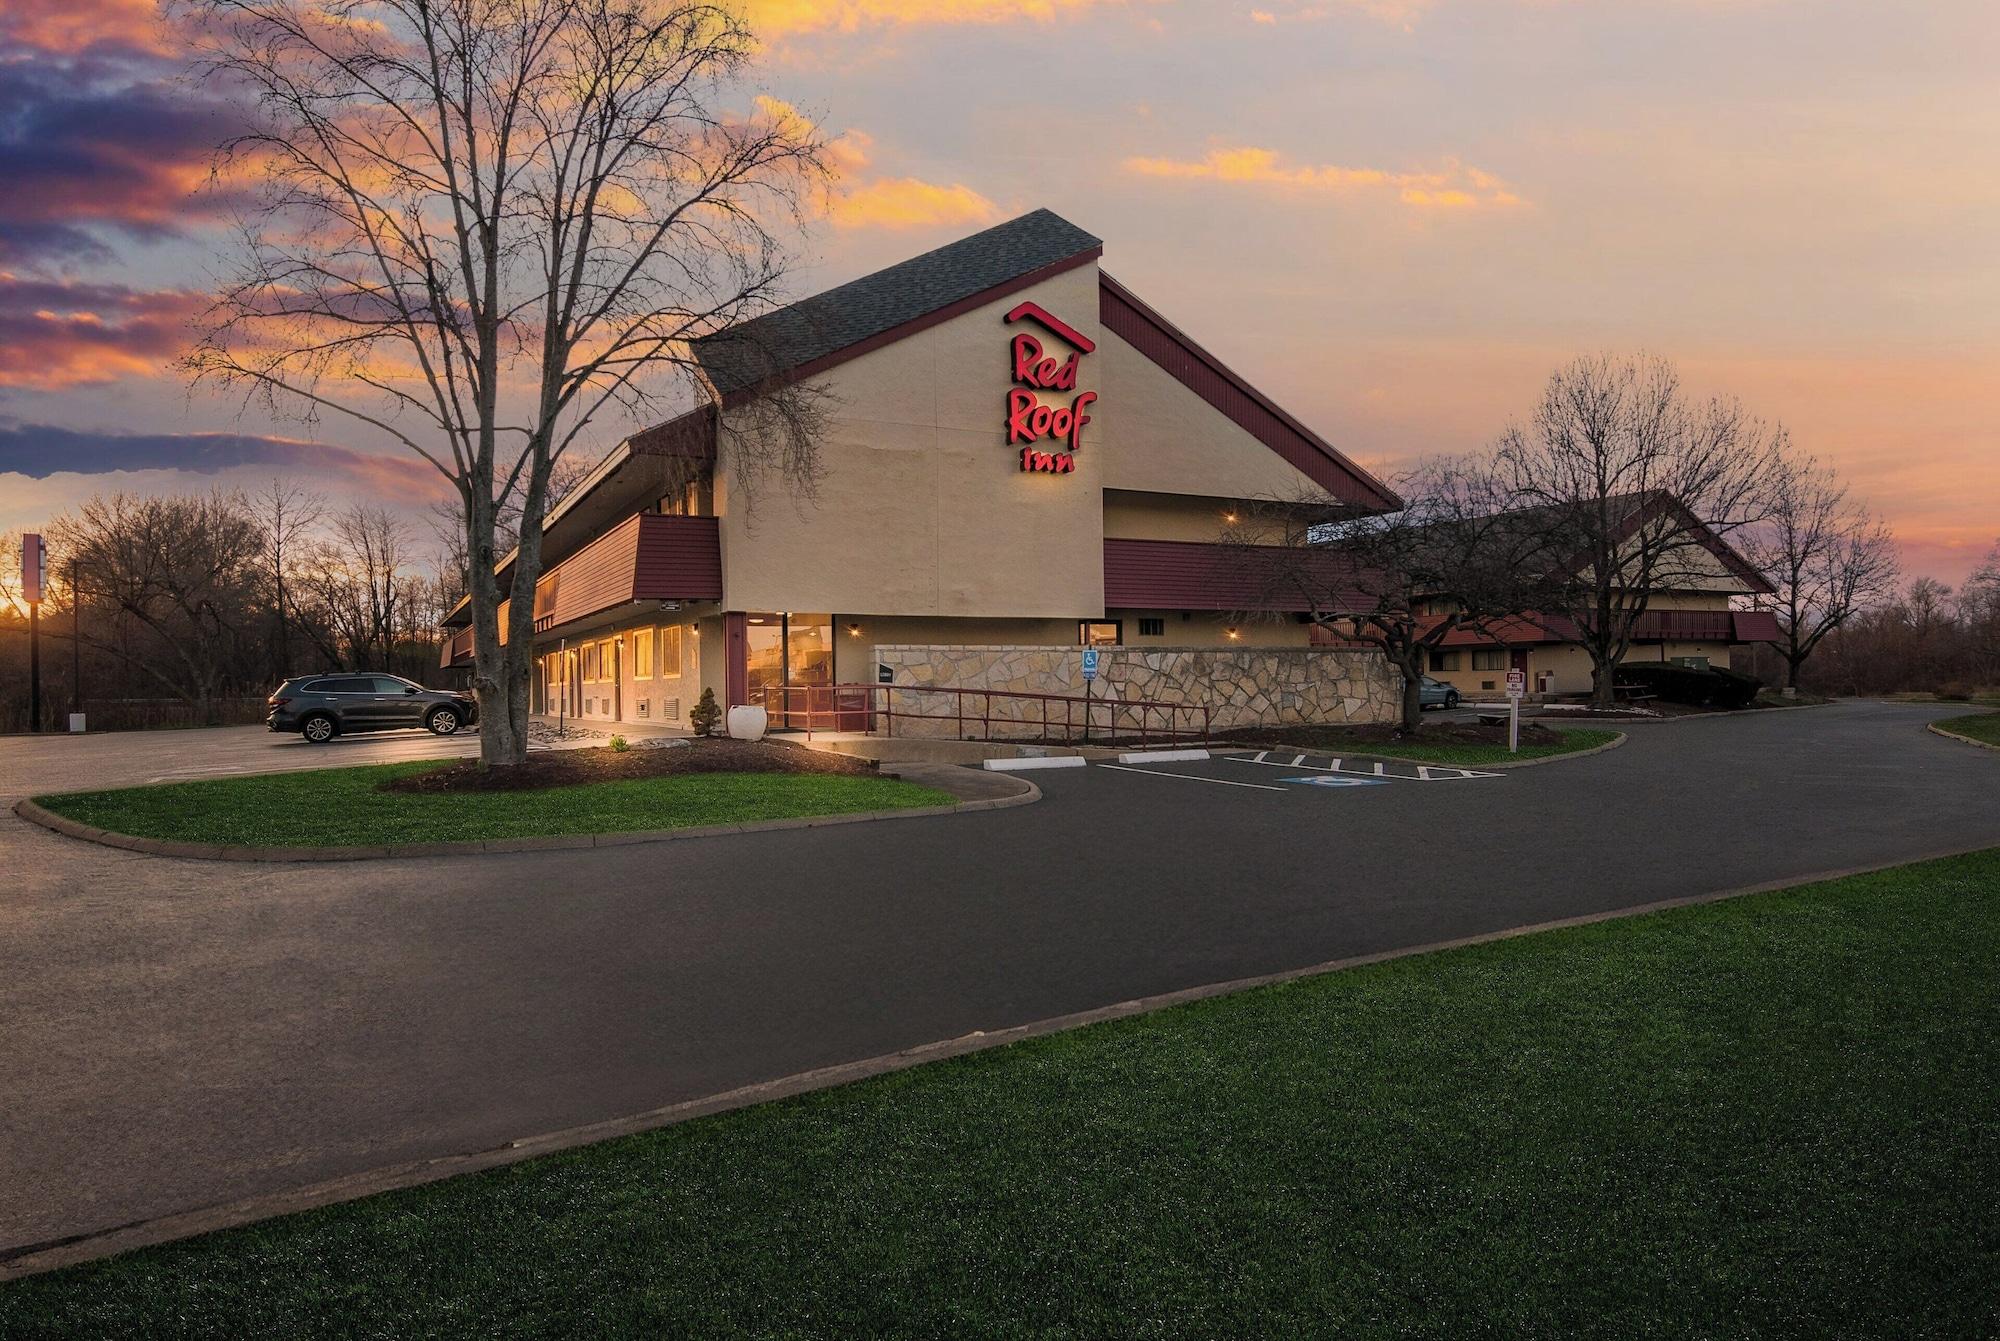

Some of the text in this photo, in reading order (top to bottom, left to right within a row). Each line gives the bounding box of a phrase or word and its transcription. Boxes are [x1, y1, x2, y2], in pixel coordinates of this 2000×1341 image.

[1011, 334, 1080, 391] Red
[1005, 388, 1097, 452] Roof
[1020, 447, 1076, 473] Inn
